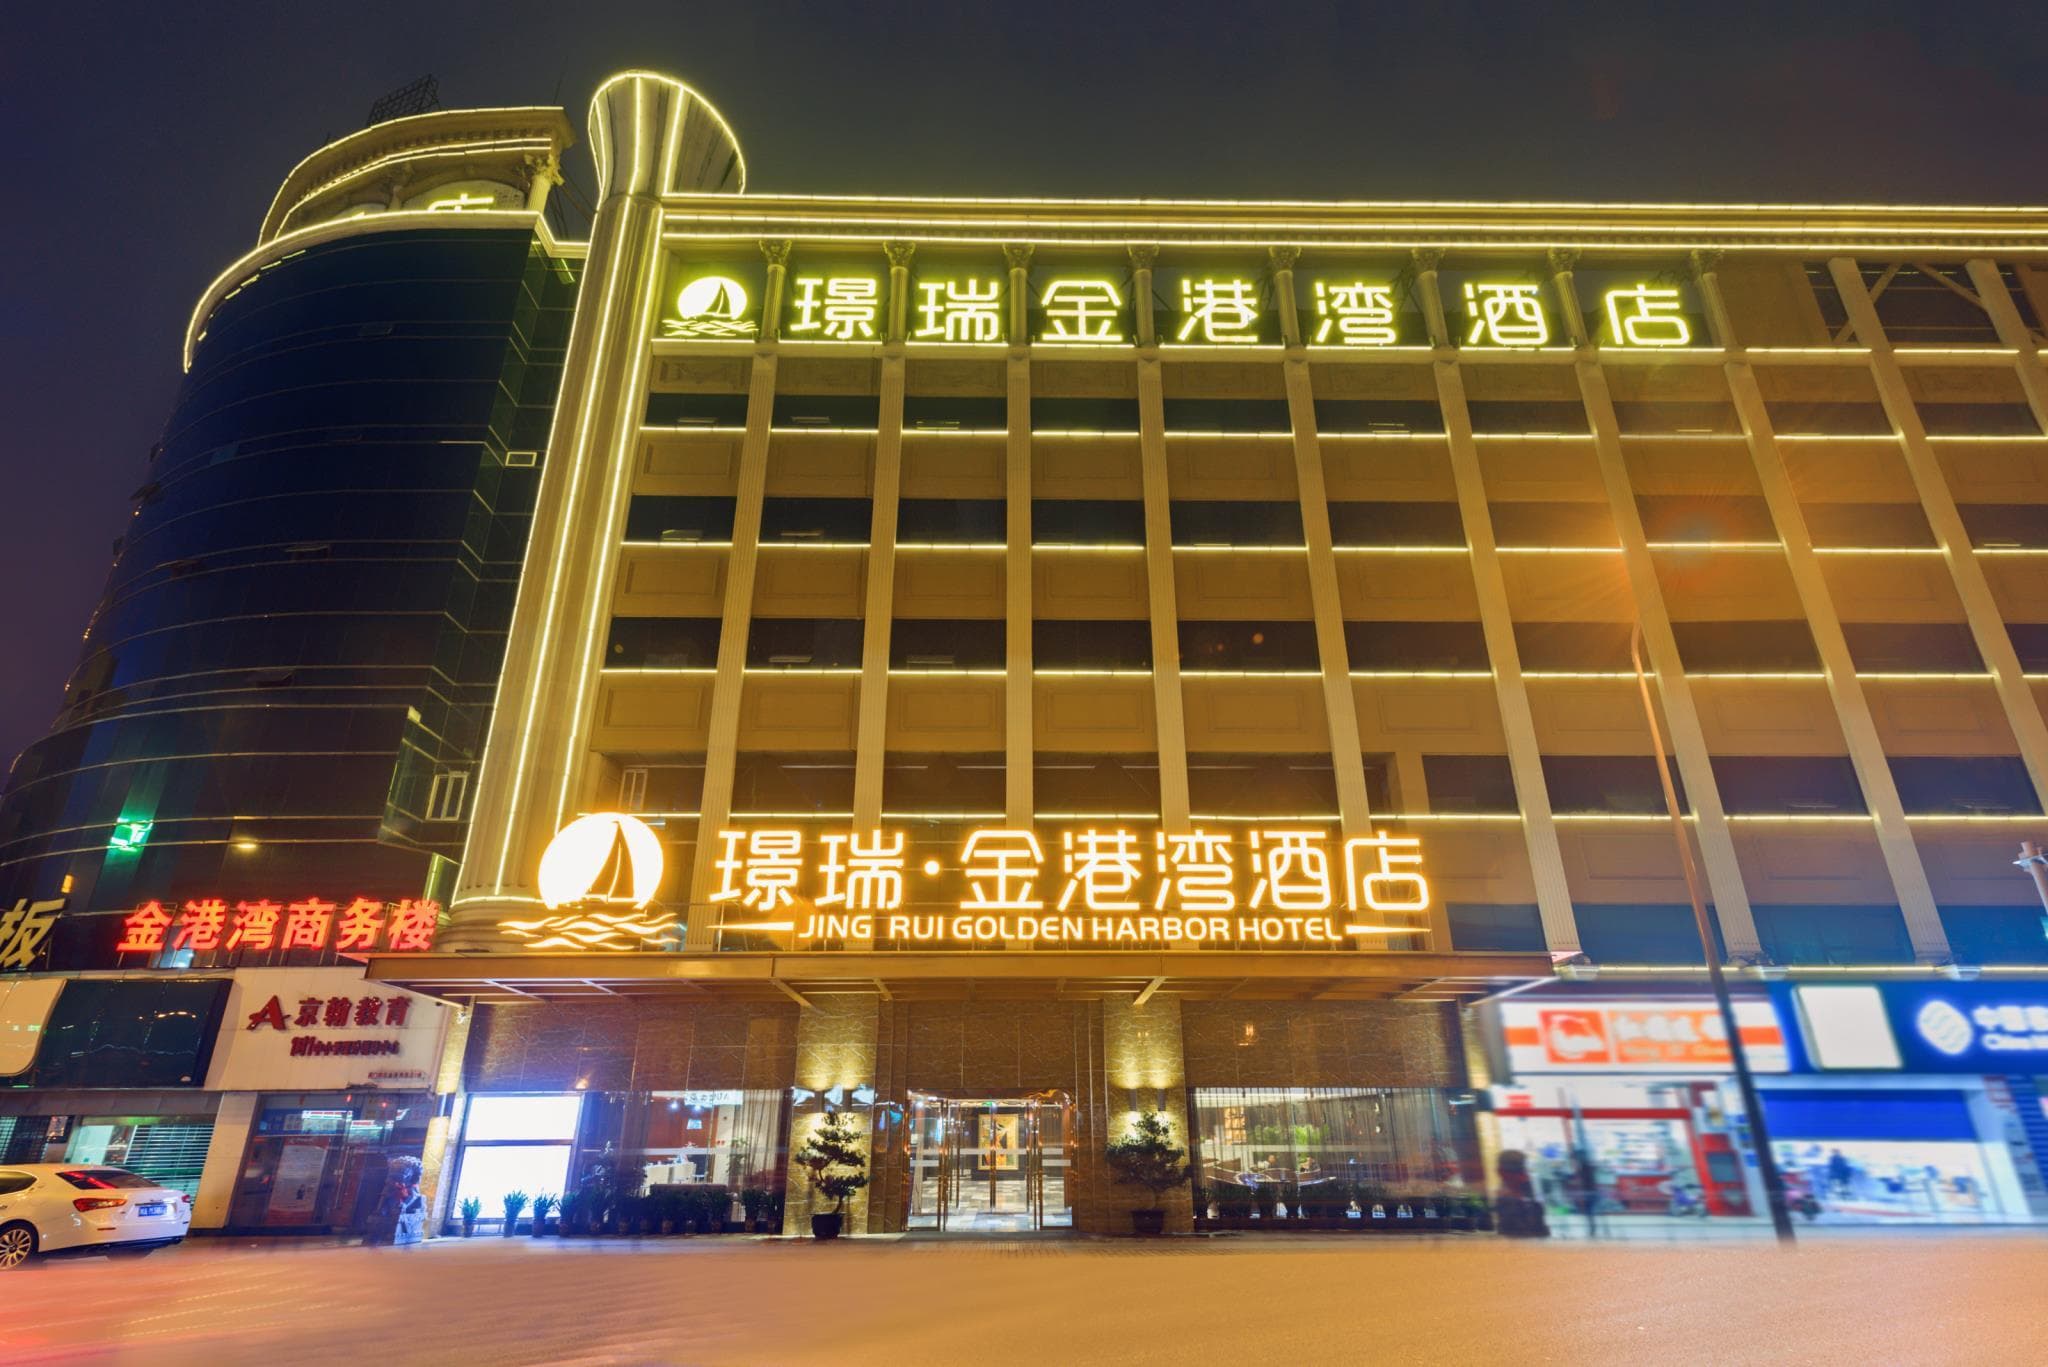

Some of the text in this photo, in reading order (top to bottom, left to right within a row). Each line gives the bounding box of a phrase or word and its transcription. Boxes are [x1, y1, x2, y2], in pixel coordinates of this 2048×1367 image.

[789, 277, 1691, 345] 璟瑞金港湾酒店
[117, 898, 440, 952] 金港湾商务楼
[798, 914, 1343, 942] JING RUI GOLDEN HARBOR HOTEL
